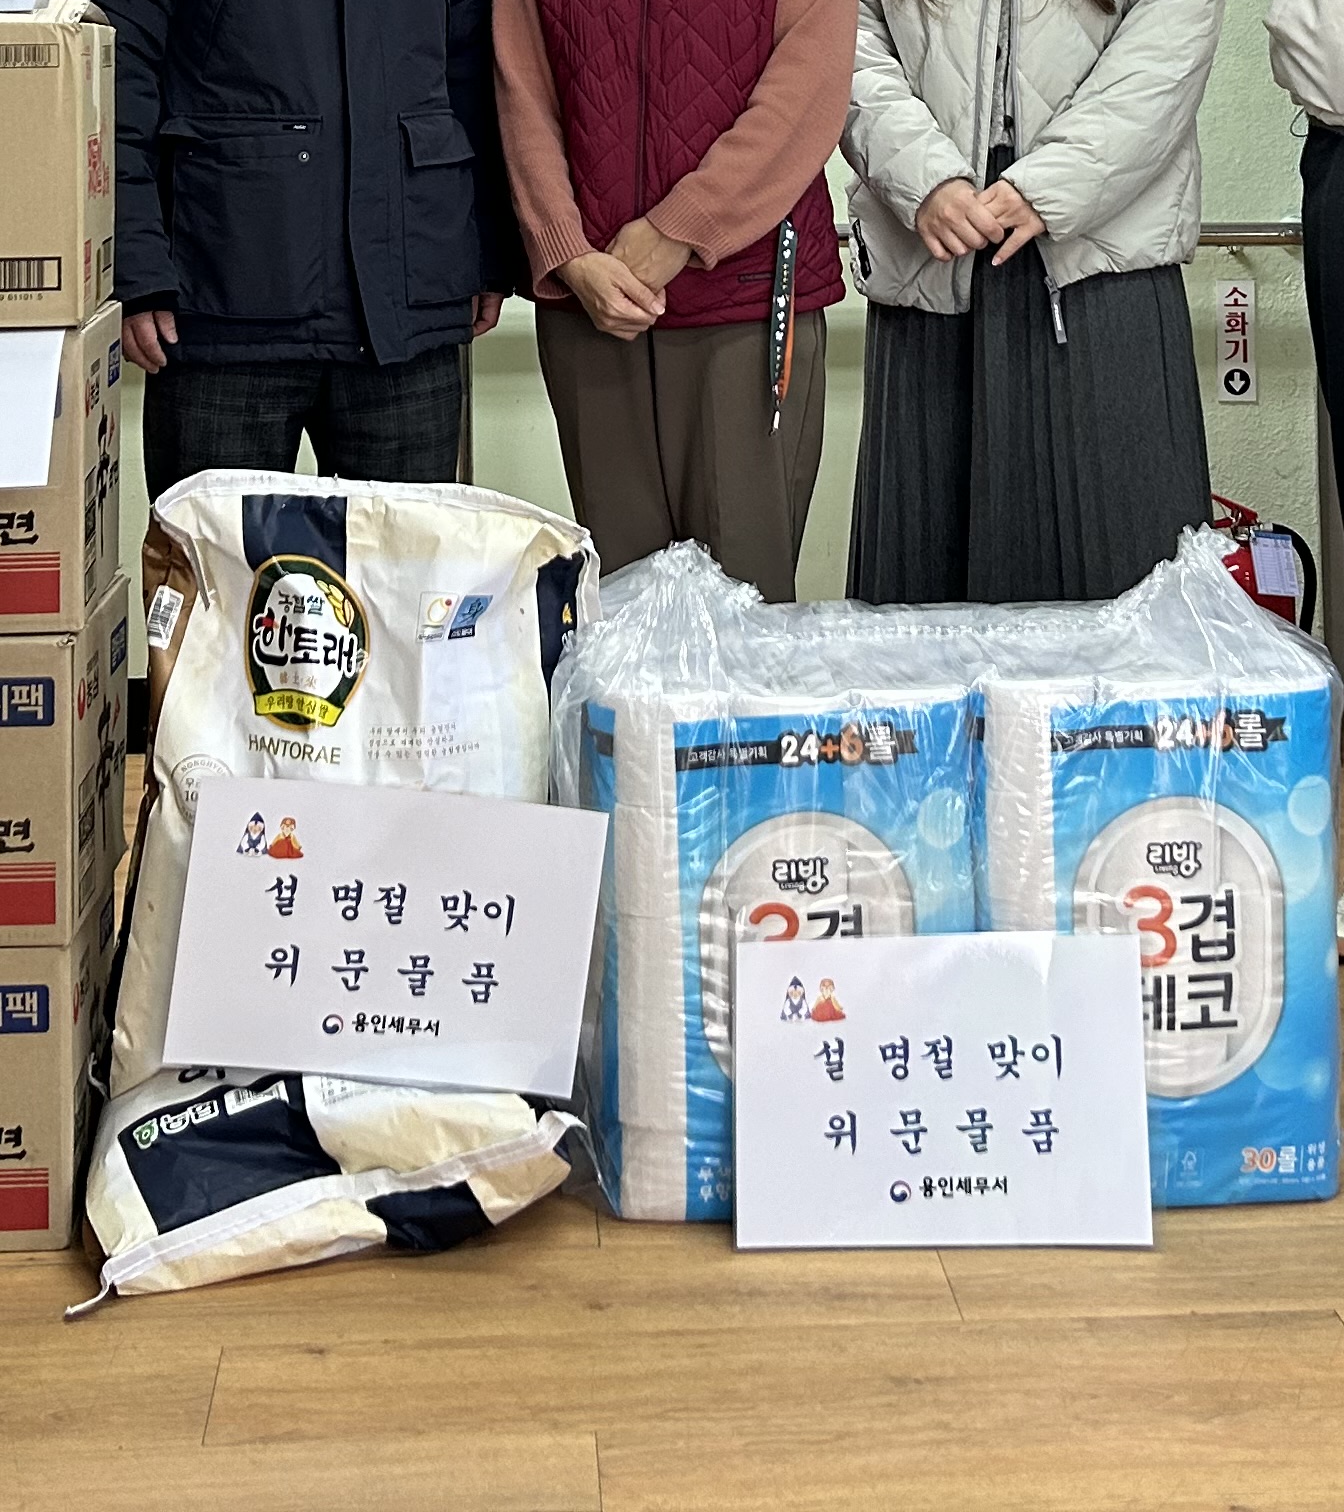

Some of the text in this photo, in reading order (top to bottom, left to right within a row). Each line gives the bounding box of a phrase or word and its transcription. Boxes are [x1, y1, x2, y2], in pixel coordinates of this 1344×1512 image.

[1223, 286, 1250, 364] 소화기
[254, 606, 355, 674] 한토래
[248, 733, 342, 766] HANTORAE
[773, 858, 827, 893] 리빙
[1147, 841, 1201, 877] 리빙
[264, 873, 516, 938] 설 명절 맞이
[1122, 884, 1236, 968] 3겹
[352, 1011, 441, 1038] 용인세무서
[813, 1033, 1063, 1081] 설 명절 맞이
[1241, 1145, 1298, 1173] 30롤
[919, 1175, 1009, 1199] 용인세무서
